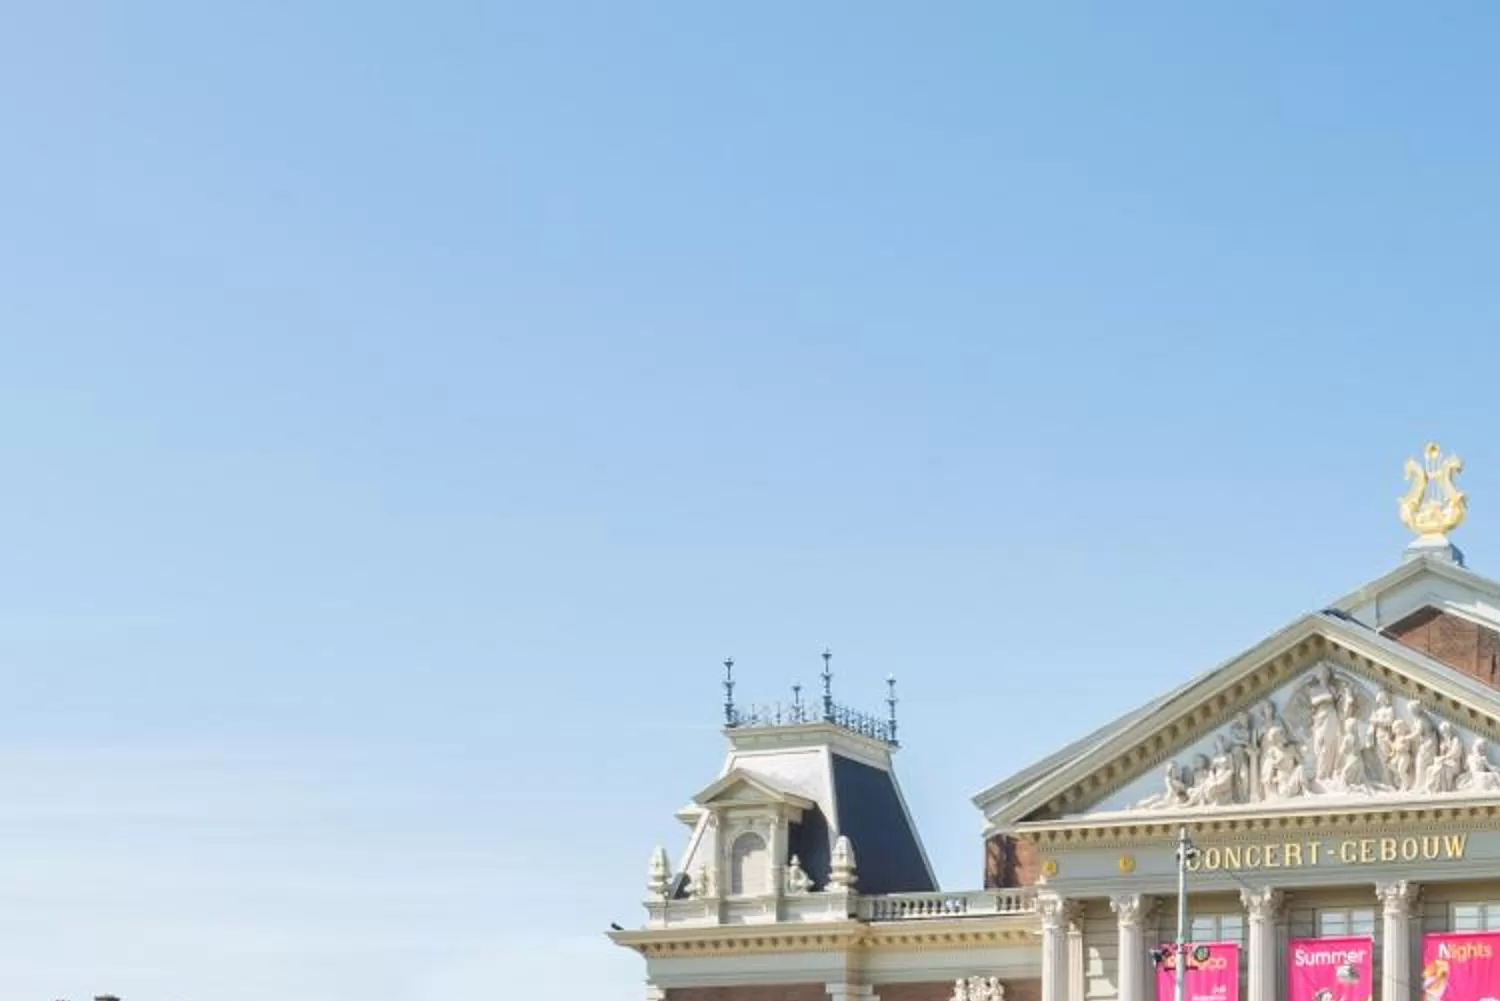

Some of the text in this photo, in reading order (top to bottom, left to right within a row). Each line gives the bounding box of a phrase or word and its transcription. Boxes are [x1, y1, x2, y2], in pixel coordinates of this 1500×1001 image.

[1186, 834, 1467, 871] CONCERT-GEBOUW
[1295, 949, 1367, 967] Summer
[1438, 943, 1493, 961] Nights
